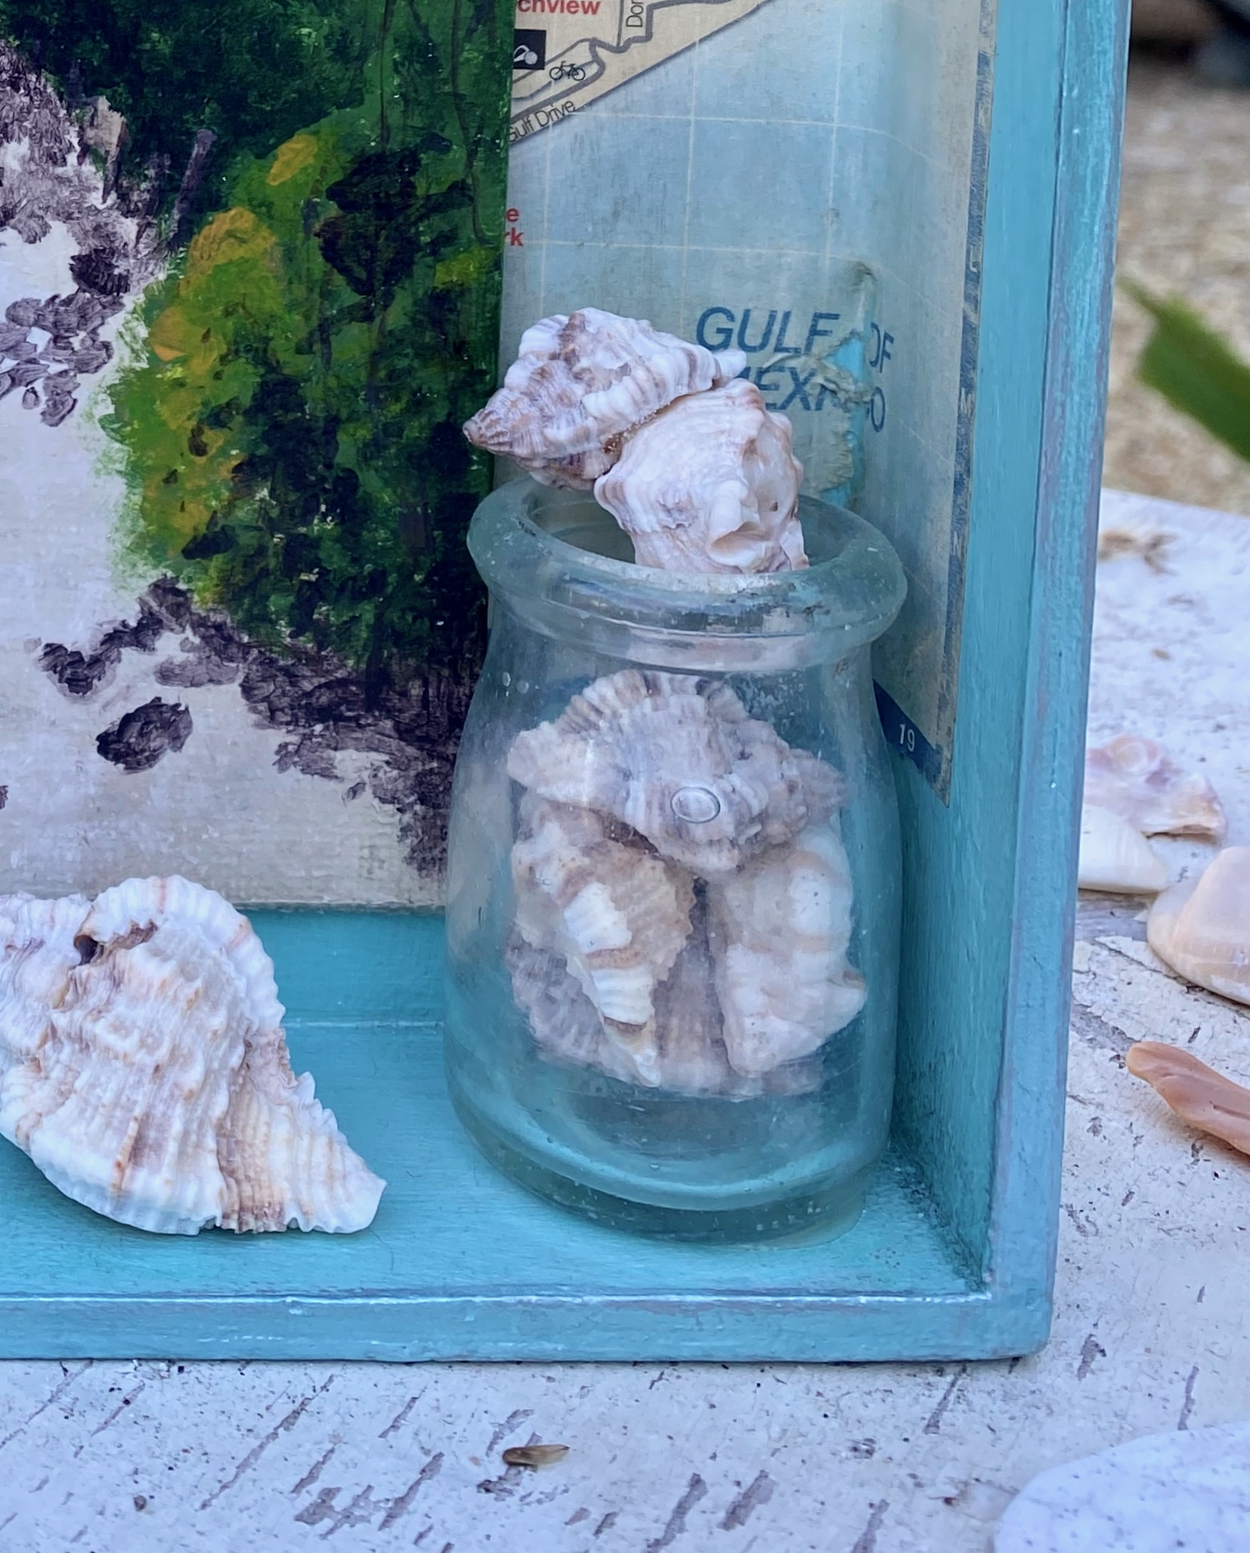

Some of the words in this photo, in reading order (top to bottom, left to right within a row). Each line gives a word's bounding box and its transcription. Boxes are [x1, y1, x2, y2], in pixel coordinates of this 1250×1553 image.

[535, 99, 576, 128] Drive
[696, 306, 841, 354] GULF
[898, 722, 916, 752] 19
